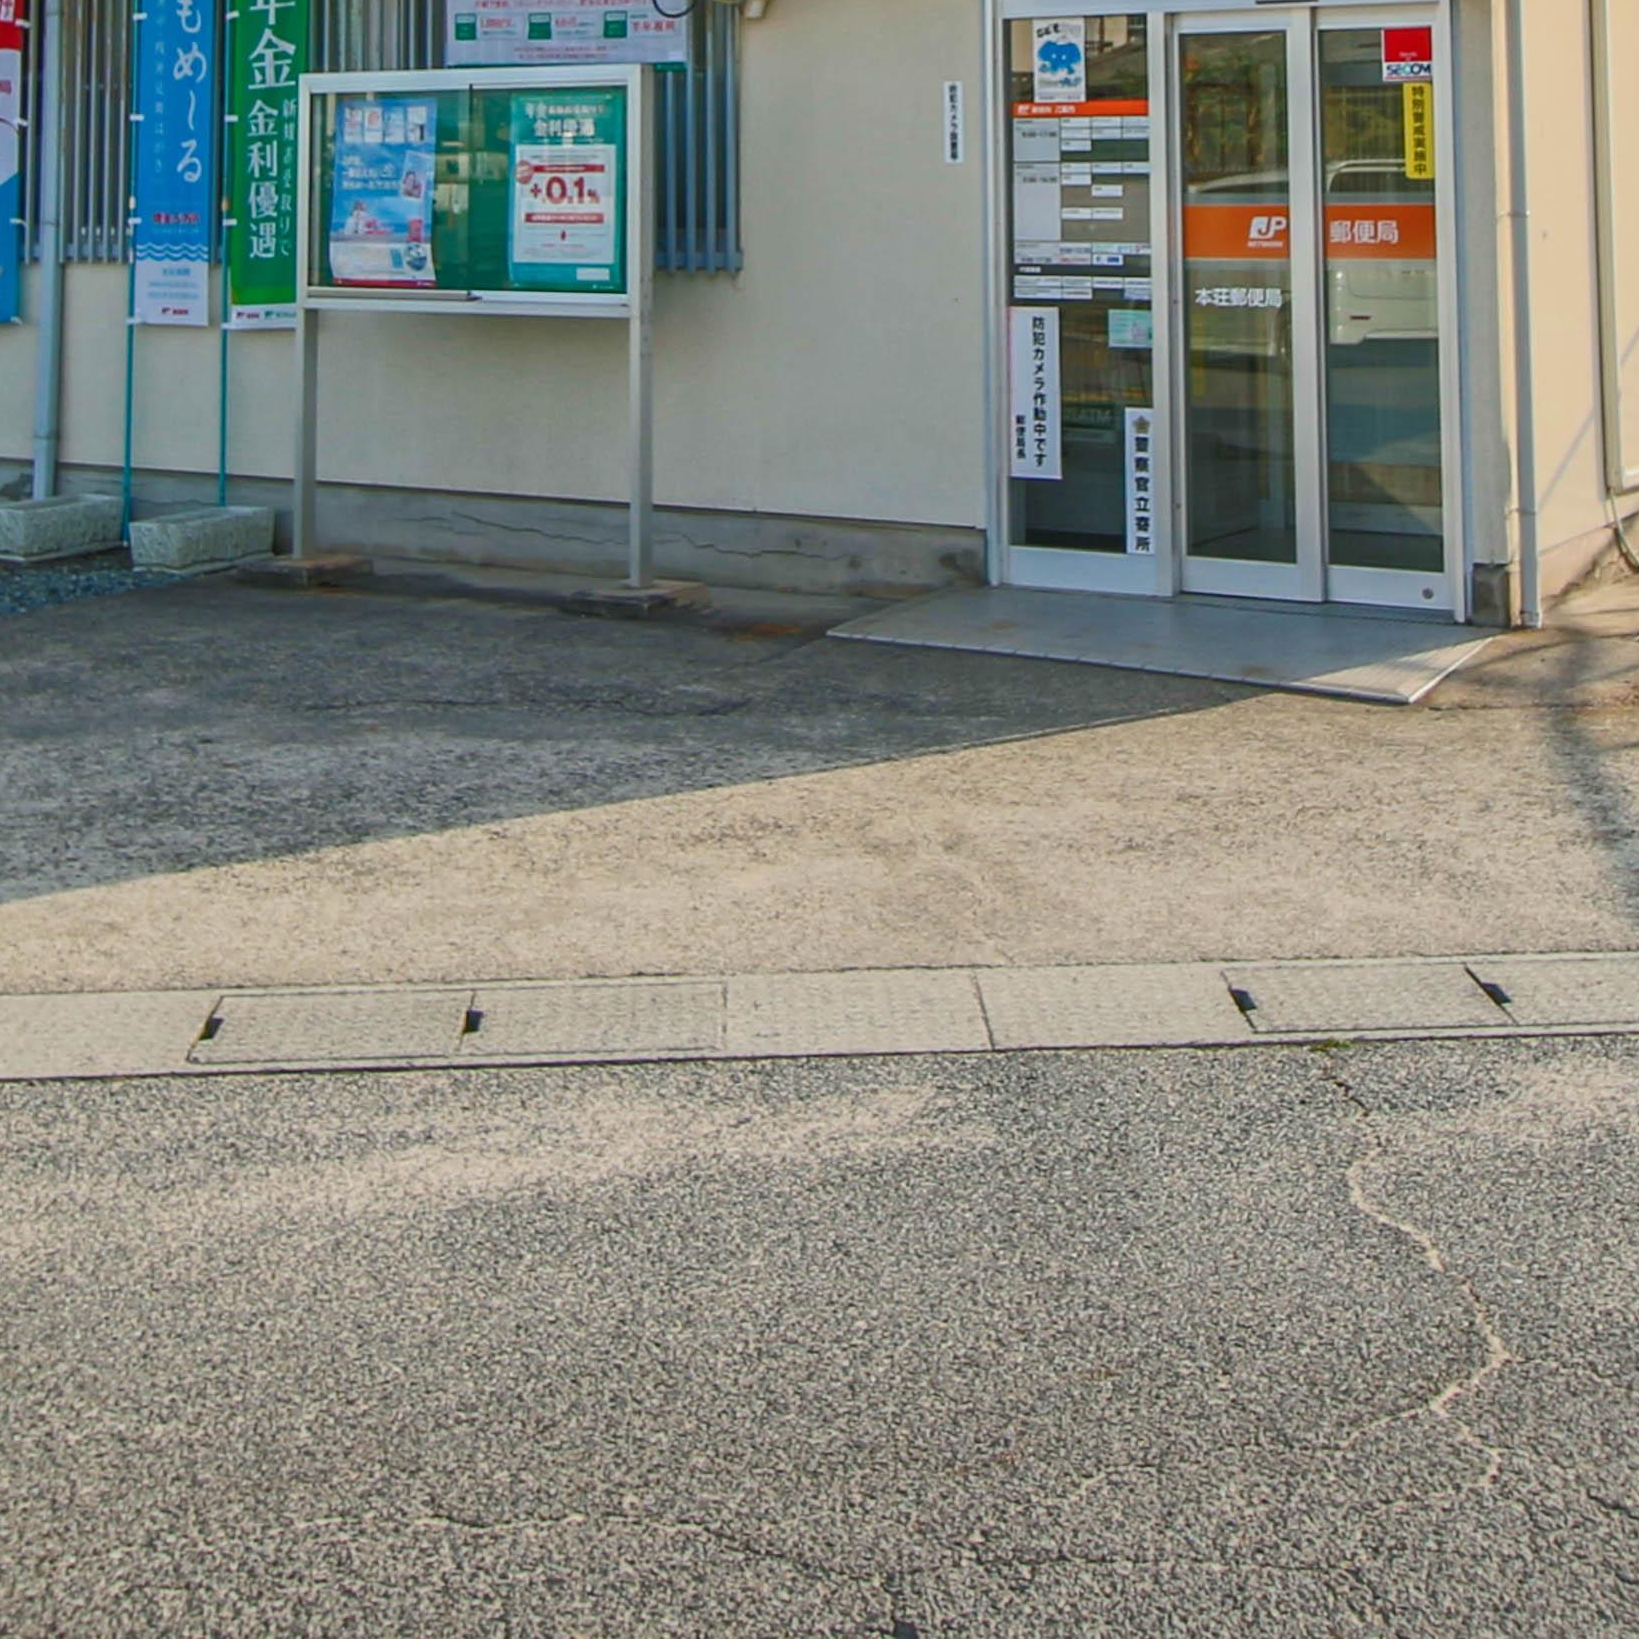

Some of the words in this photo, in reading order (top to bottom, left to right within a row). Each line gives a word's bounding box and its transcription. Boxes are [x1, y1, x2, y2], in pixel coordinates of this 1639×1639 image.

[1385, 63, 1431, 76] SECOM
[247, 98, 279, 258] 金利優遇
[1329, 219, 1399, 245] 郵便局
[1194, 286, 1283, 309] 本荘郵便局
[1032, 316, 1047, 467] 防犯カメラ作動中です
[1134, 436, 1150, 553] 警察官立寄所
